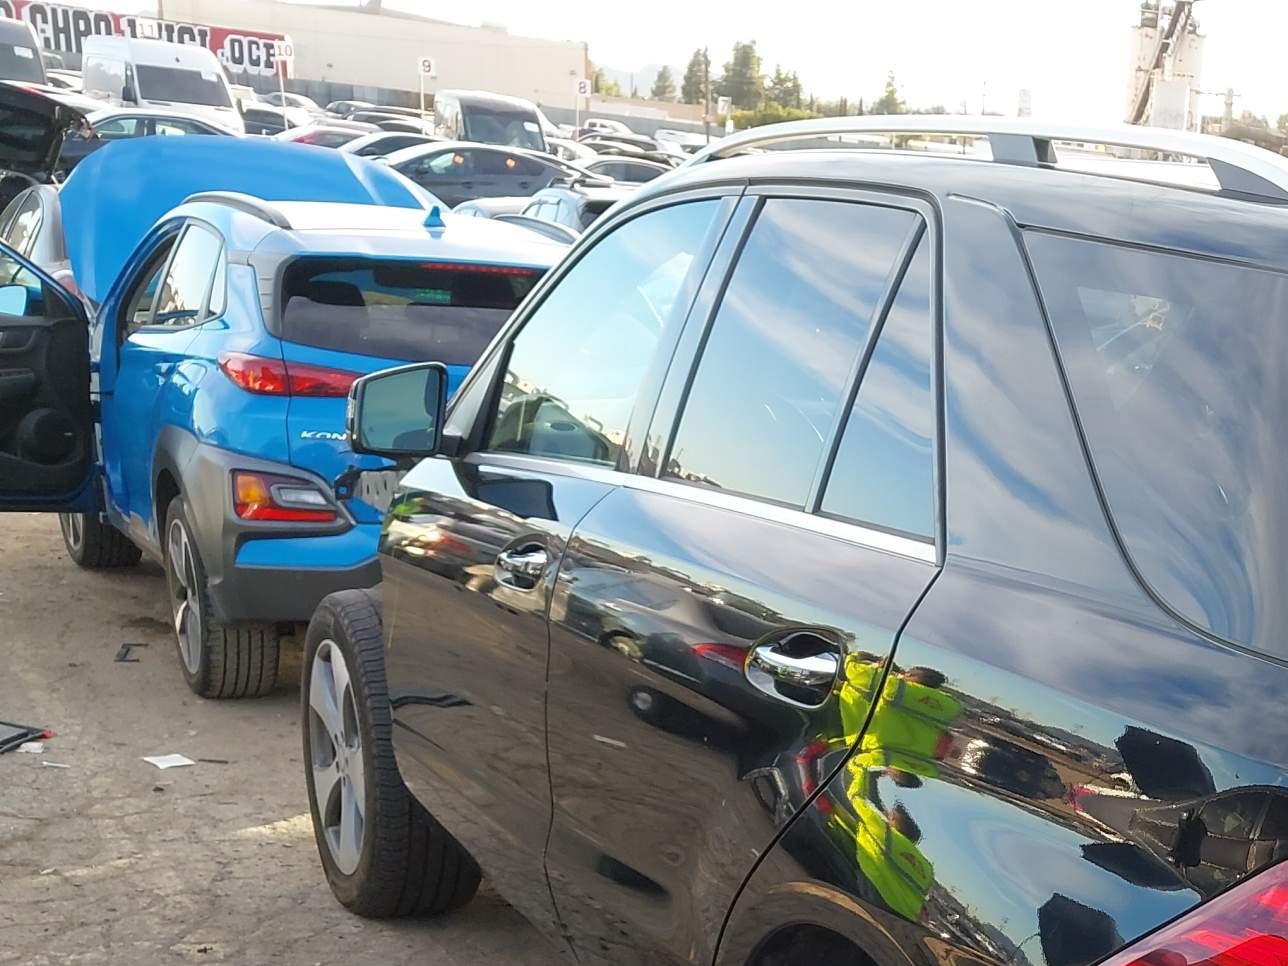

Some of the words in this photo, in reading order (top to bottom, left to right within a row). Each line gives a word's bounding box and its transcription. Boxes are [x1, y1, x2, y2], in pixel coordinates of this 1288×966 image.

[277, 44, 292, 57] 10
[422, 60, 431, 73] 9
[578, 81, 587, 95] 8
[301, 430, 346, 441] KON
